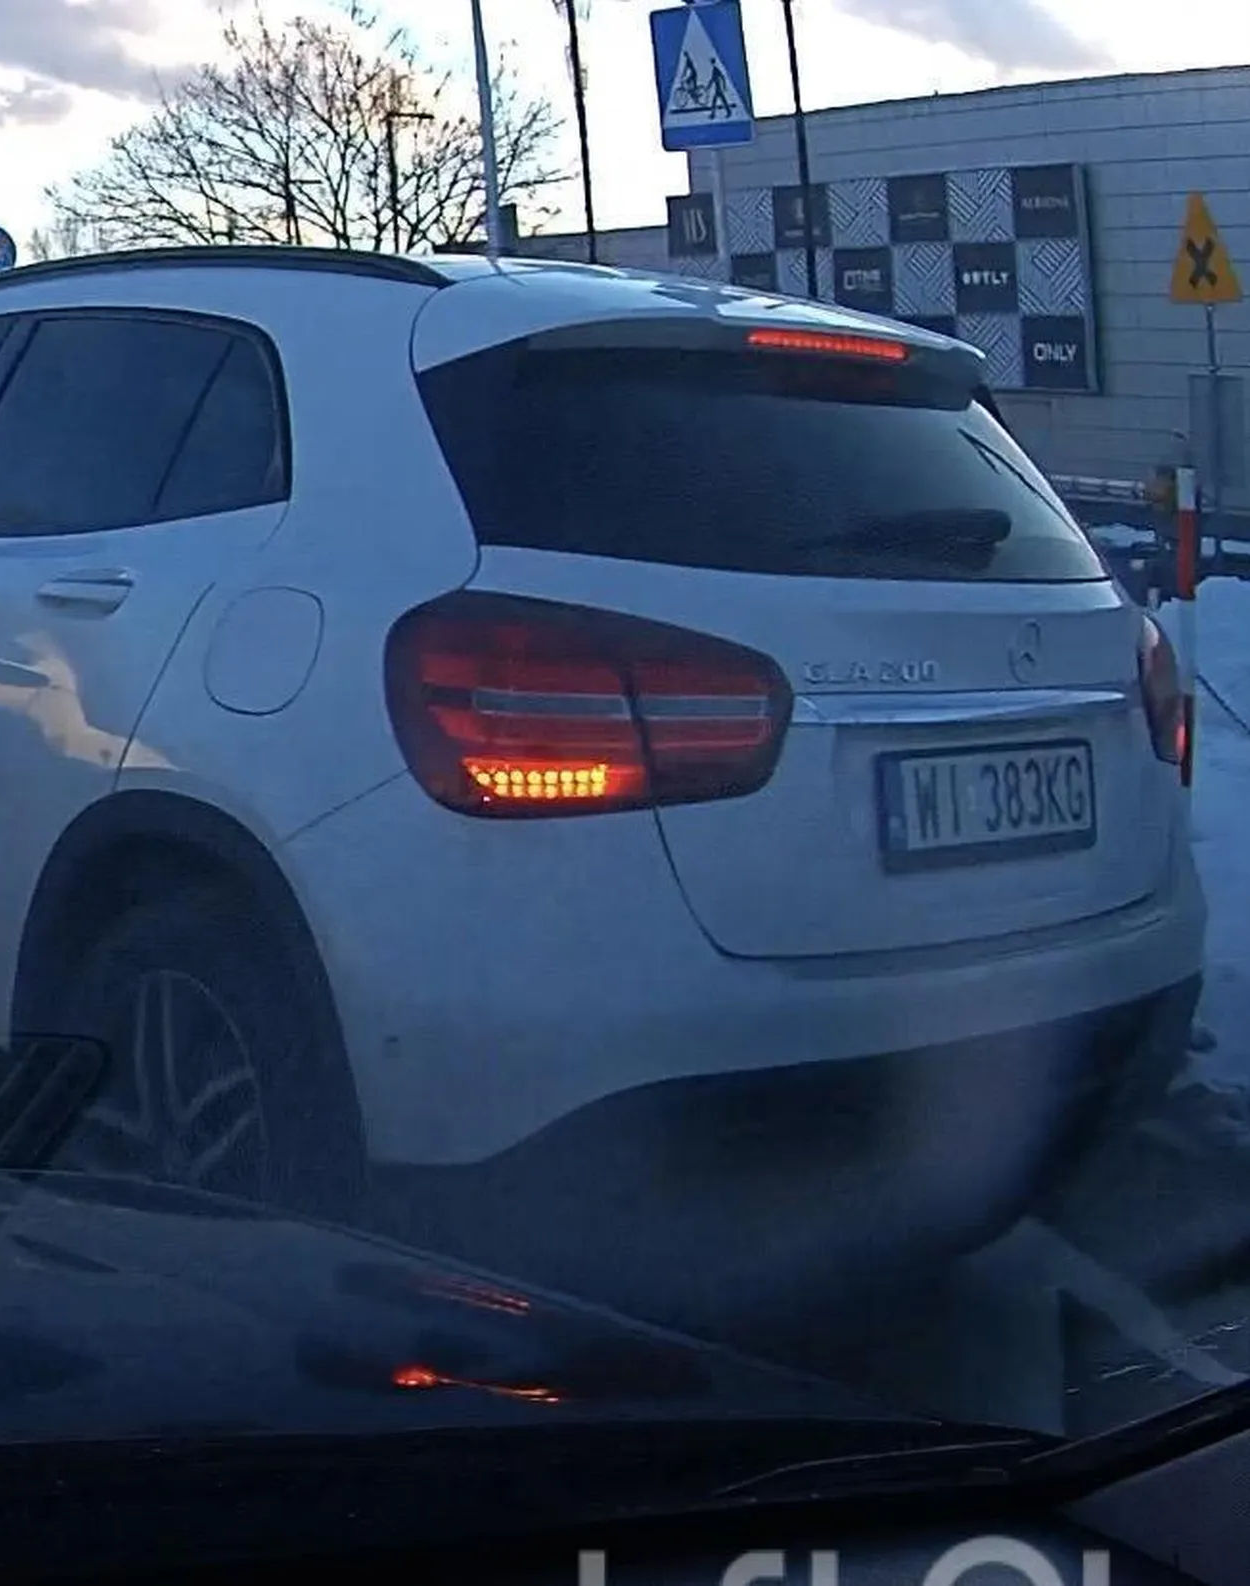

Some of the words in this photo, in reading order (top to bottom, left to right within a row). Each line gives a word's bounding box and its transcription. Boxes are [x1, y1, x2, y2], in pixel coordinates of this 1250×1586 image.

[1033, 343, 1077, 362] ONLY
[912, 765, 963, 840] WI
[979, 756, 1086, 832] 383KG
